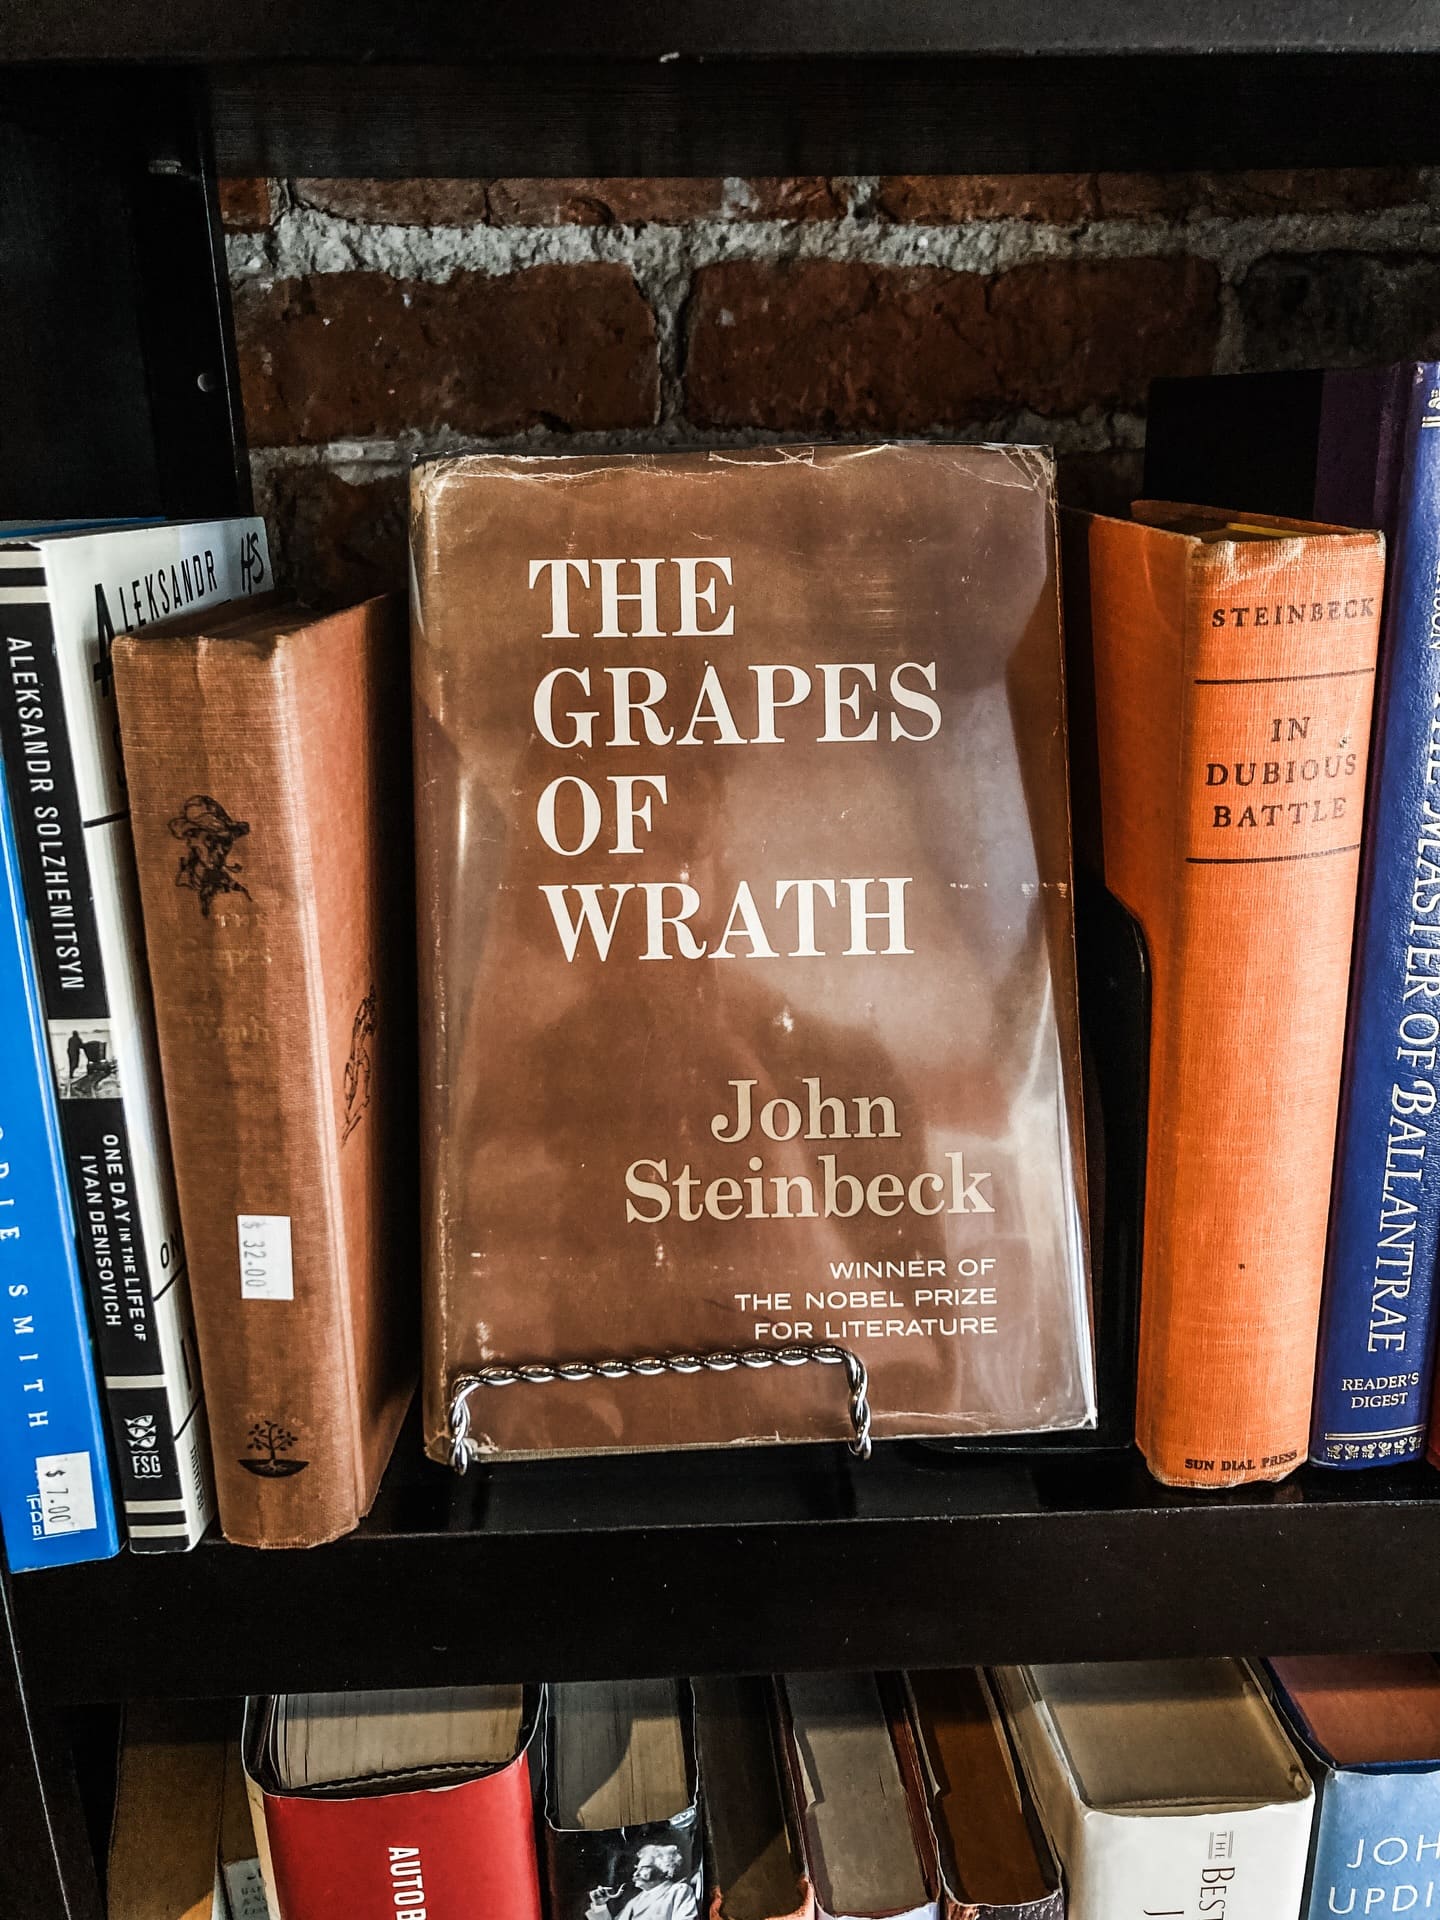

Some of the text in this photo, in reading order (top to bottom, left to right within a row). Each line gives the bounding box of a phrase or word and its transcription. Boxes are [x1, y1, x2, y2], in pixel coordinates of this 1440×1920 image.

[529, 556, 735, 638] THE
[1212, 596, 1376, 627] STEINBECK
[533, 661, 942, 749] GRAPES
[1271, 716, 1311, 743] IN
[1207, 752, 1357, 787] DUBIOUS
[6, 637, 85, 989] ALEKSANDR SOLZHENITSYN
[536, 774, 668, 857] OF
[1213, 797, 1347, 828] BATTLE
[538, 877, 915, 962] WRATH
[1397, 1012, 1440, 1071] OF
[711, 1077, 901, 1144] John
[625, 1152, 995, 1223] Steinbeck
[1367, 1077, 1437, 1353] BALLANTRAE
[80, 1155, 122, 1326] IVAN DENISOVICH
[102, 1134, 147, 1342] ONE DAY IN THE LIFE OF
[243, 1240, 267, 1288] 32.00
[829, 1258, 996, 1279] WINNER OF
[734, 1288, 997, 1312] THE NOBEL PRIZE
[754, 1315, 998, 1340] FOR LITERATURE
[9, 1284, 49, 1428] SMITH
[1341, 1372, 1419, 1391] READER'S
[1351, 1392, 1409, 1409] DIGEST
[132, 1456, 162, 1474] FSG
[1185, 1450, 1298, 1472] SUN DIAL PRESS
[46, 1487, 71, 1523] 7.00
[1328, 1881, 1434, 1915] UPDI
